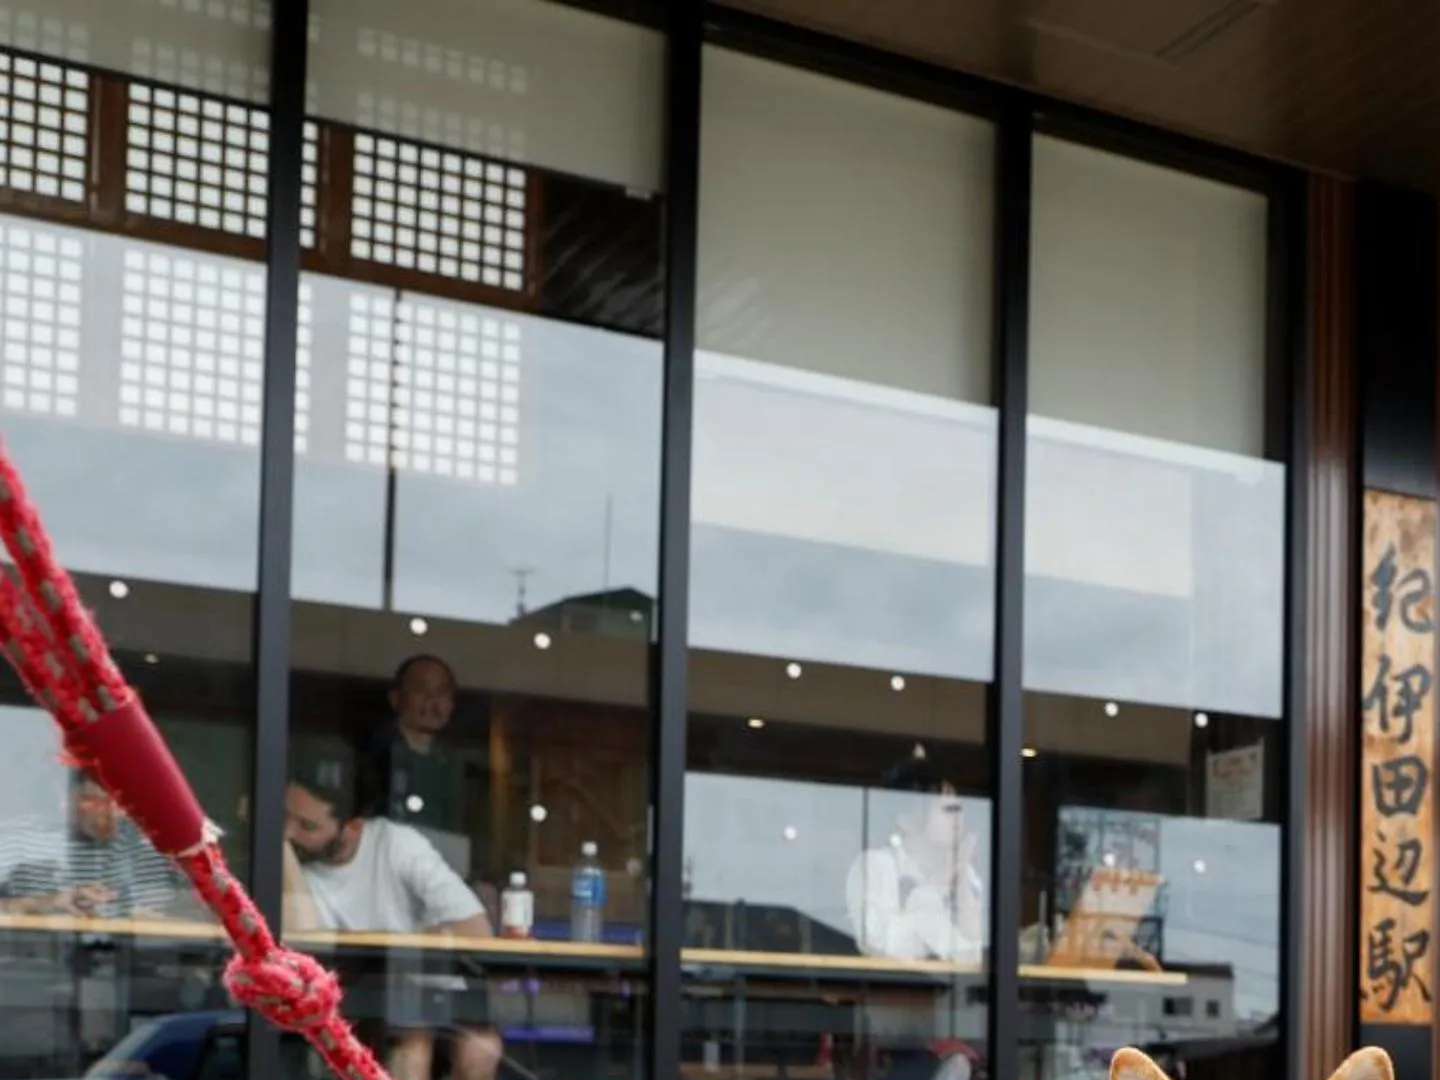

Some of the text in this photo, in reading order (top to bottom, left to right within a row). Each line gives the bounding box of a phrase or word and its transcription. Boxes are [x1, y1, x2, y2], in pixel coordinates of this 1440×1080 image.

[1364, 543, 1435, 1012] 紀伊田辺駅
